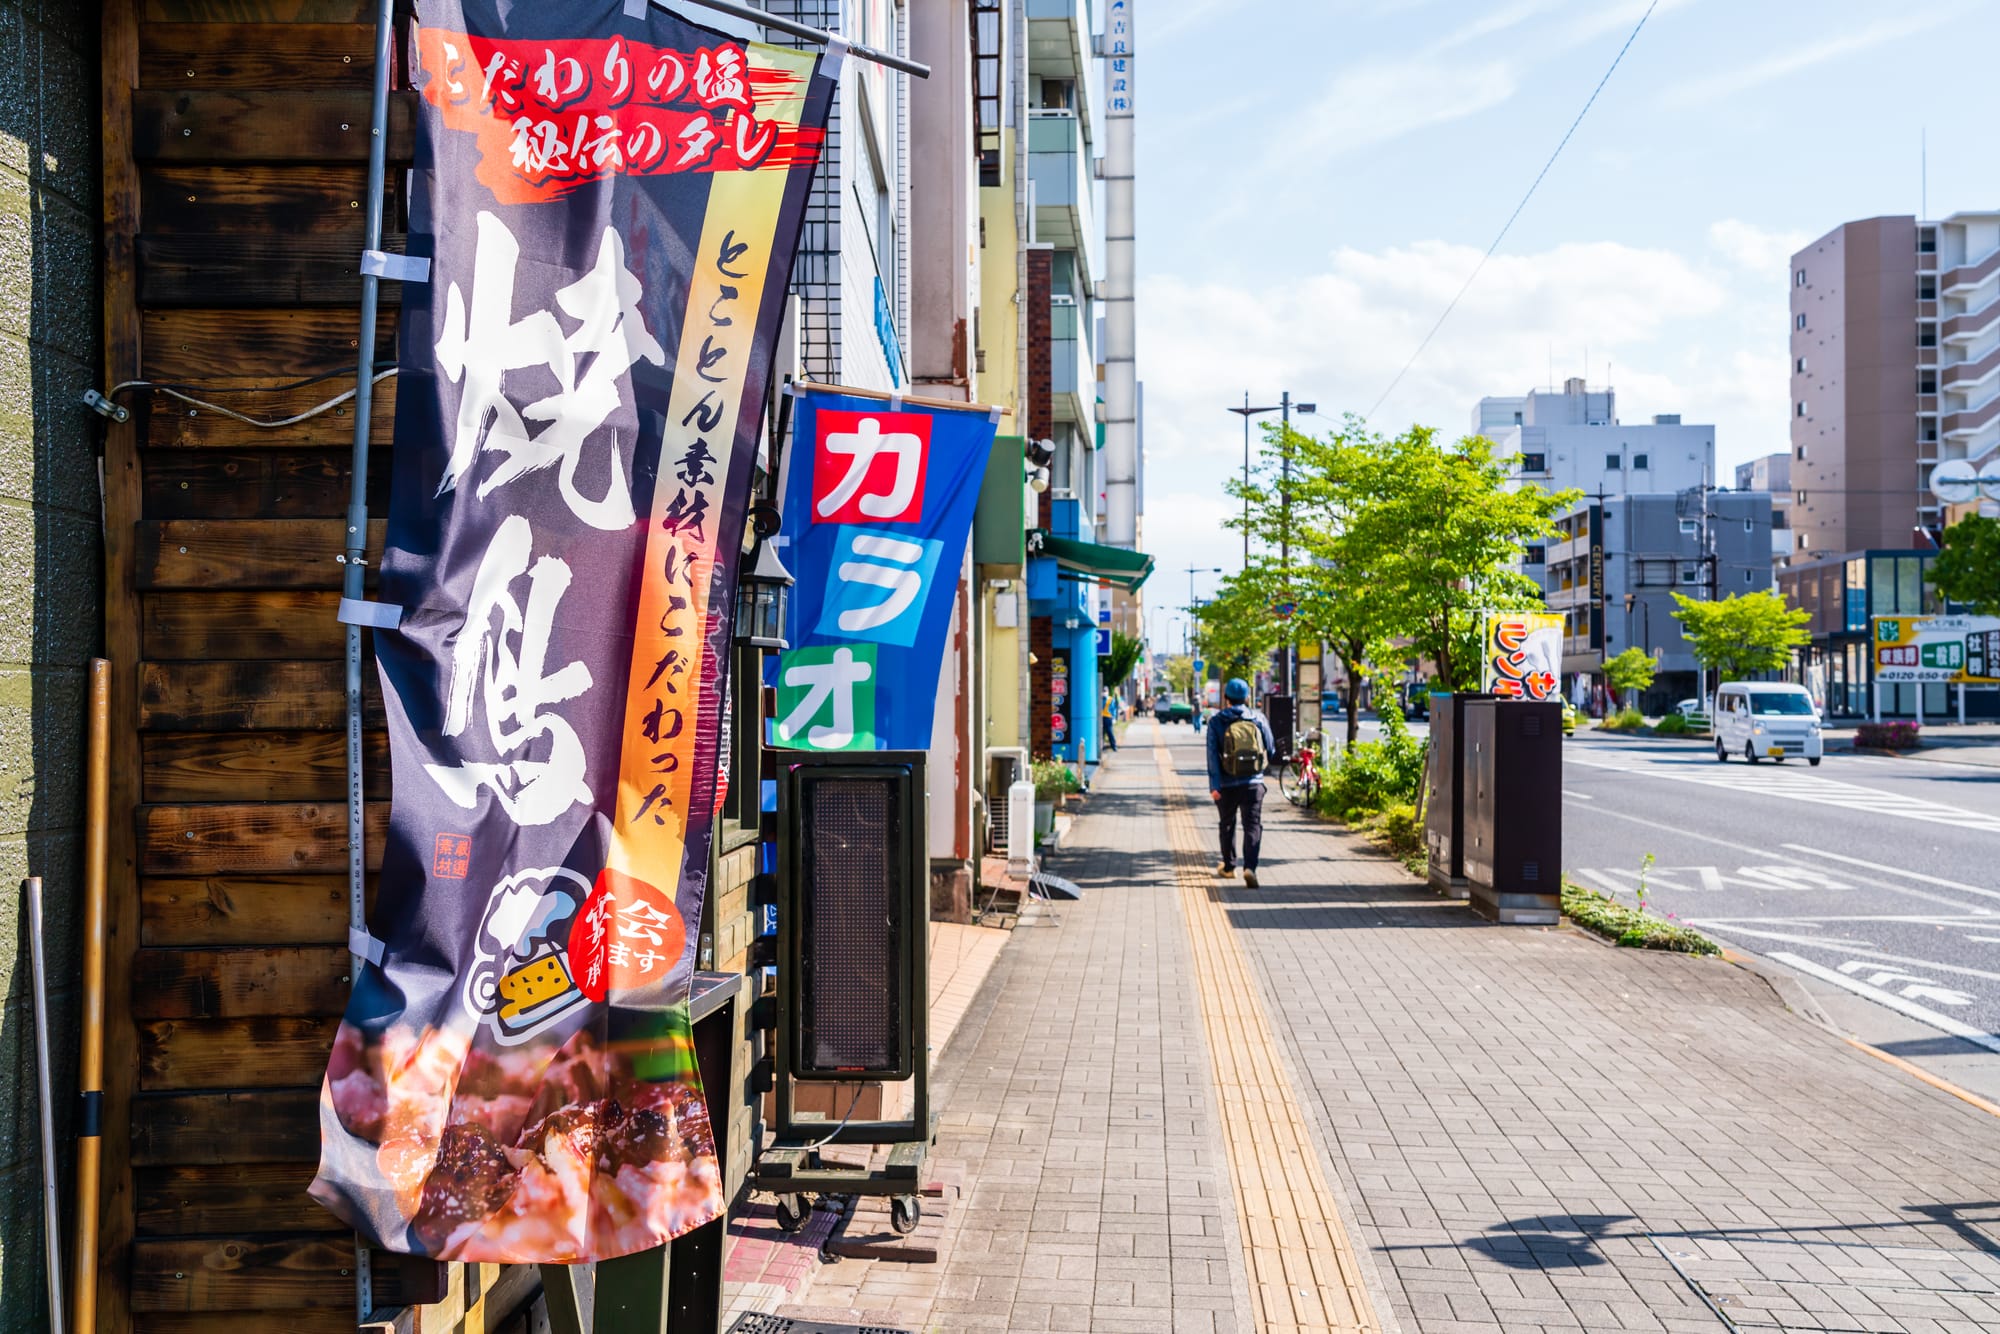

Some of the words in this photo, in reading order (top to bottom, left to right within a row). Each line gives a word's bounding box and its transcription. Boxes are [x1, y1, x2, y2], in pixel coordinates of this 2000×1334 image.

[442, 39, 749, 106] こだわりの塩
[508, 111, 778, 175] 秘伝のタレ
[421, 210, 665, 827] 焼鳥
[630, 229, 749, 826] とことん素材にこだわった
[777, 416, 924, 750] カラオ
[1592, 544, 1602, 598] CENTURY
[1923, 644, 1961, 667] 一般葬
